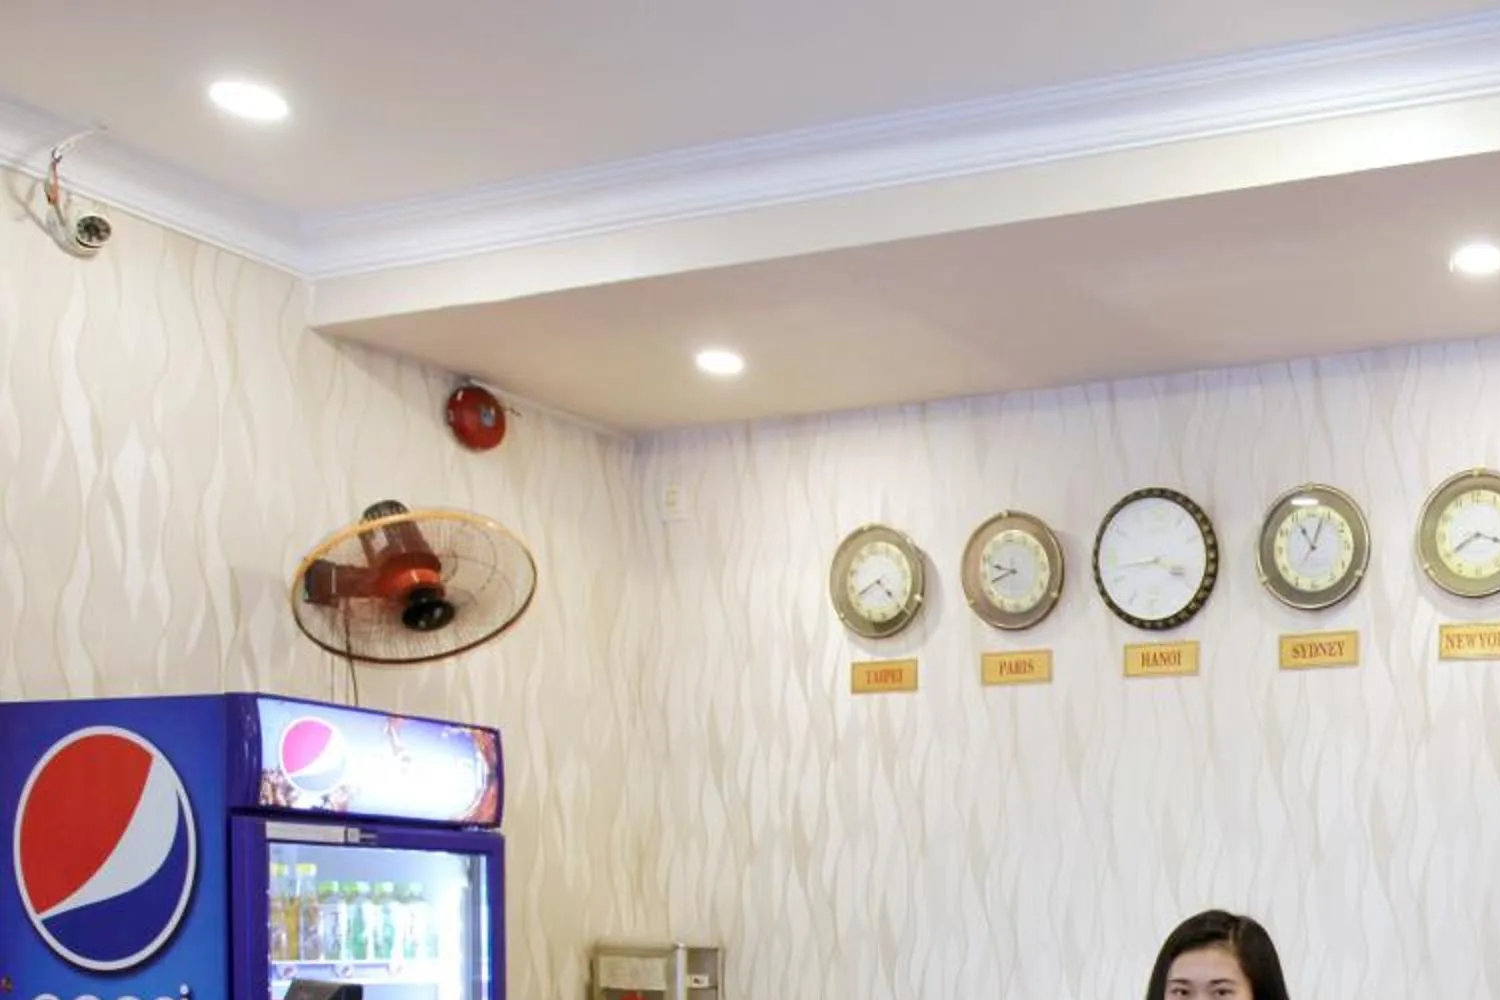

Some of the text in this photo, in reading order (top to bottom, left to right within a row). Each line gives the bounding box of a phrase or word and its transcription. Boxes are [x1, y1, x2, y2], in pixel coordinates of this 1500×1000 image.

[1291, 639, 1346, 660] SYDNEY
[1140, 651, 1182, 668] HANOI
[998, 660, 1035, 677] PARIS
